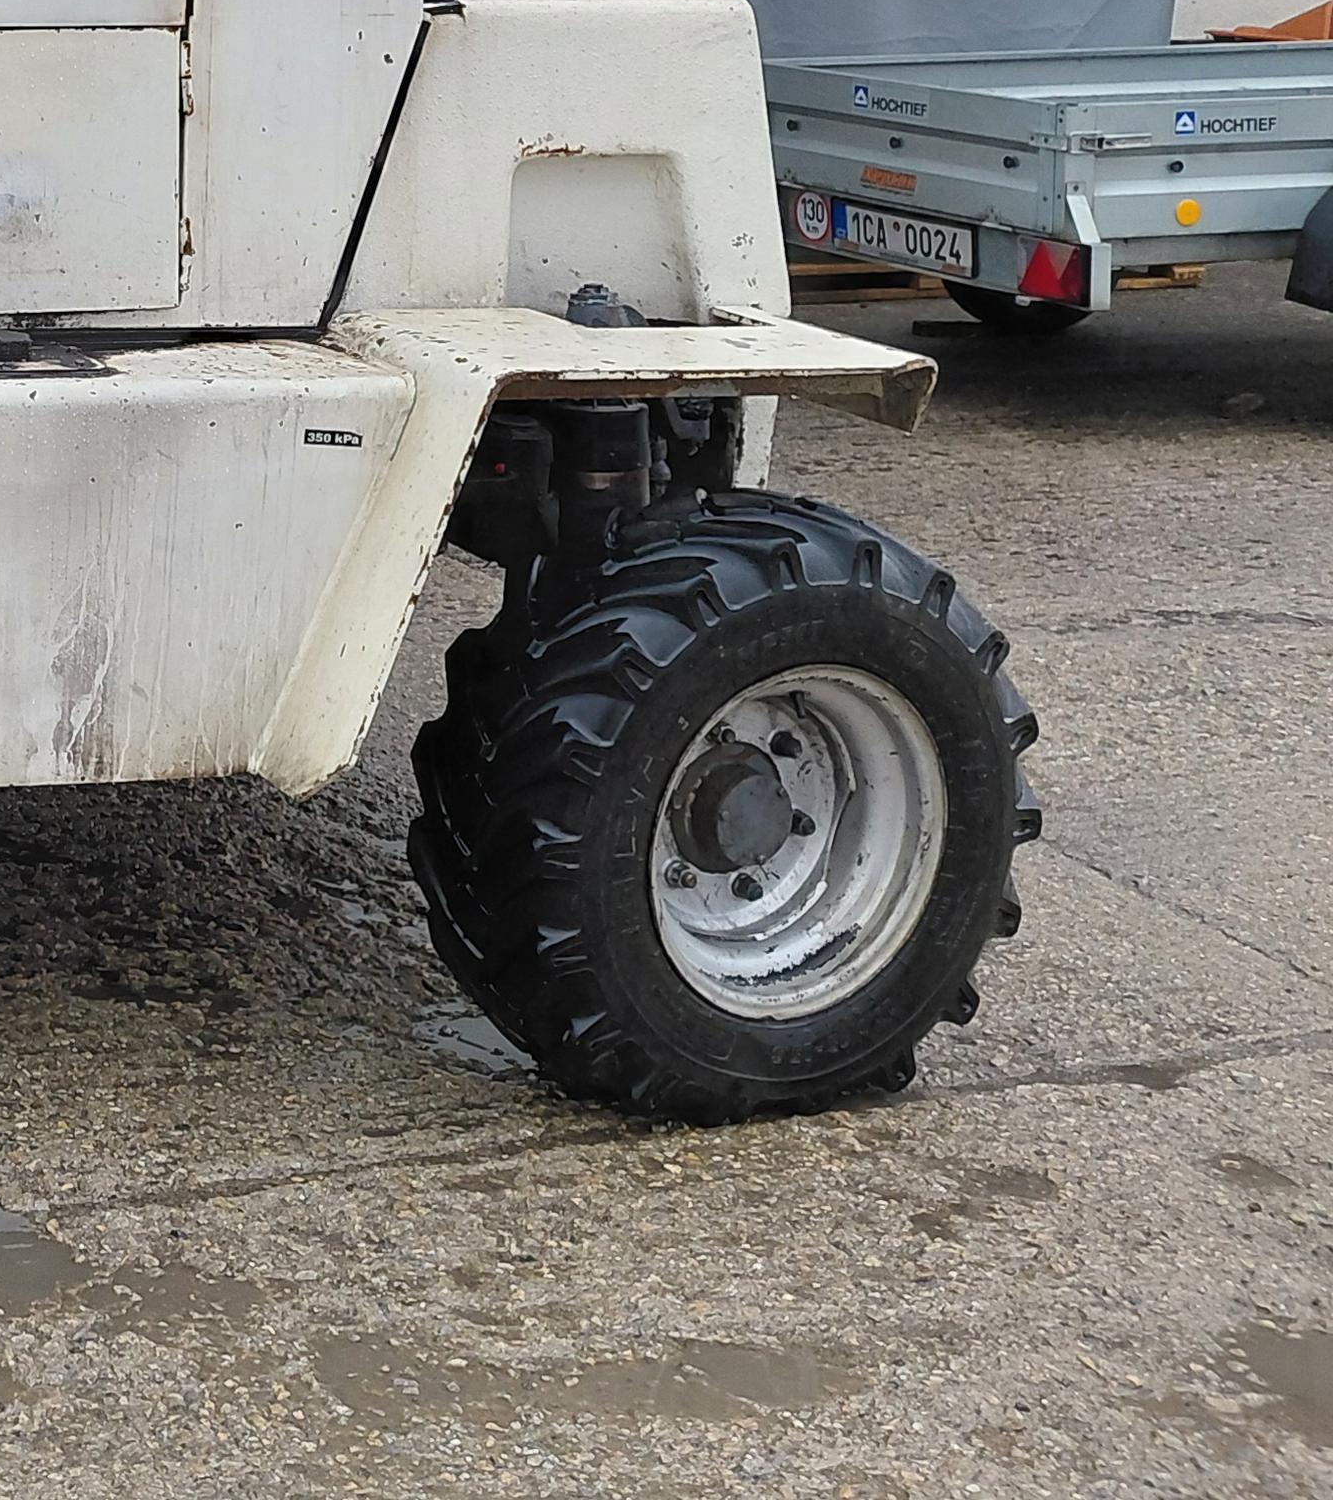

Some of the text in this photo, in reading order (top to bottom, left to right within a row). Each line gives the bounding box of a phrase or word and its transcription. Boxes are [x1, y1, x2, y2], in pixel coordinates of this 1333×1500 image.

[871, 96, 928, 117] HOCHTIEF
[1199, 117, 1277, 134] HOCHTIEF
[801, 197, 825, 224] 130
[851, 211, 963, 266] 1CA 0024
[306, 431, 360, 445] 350 kPa
